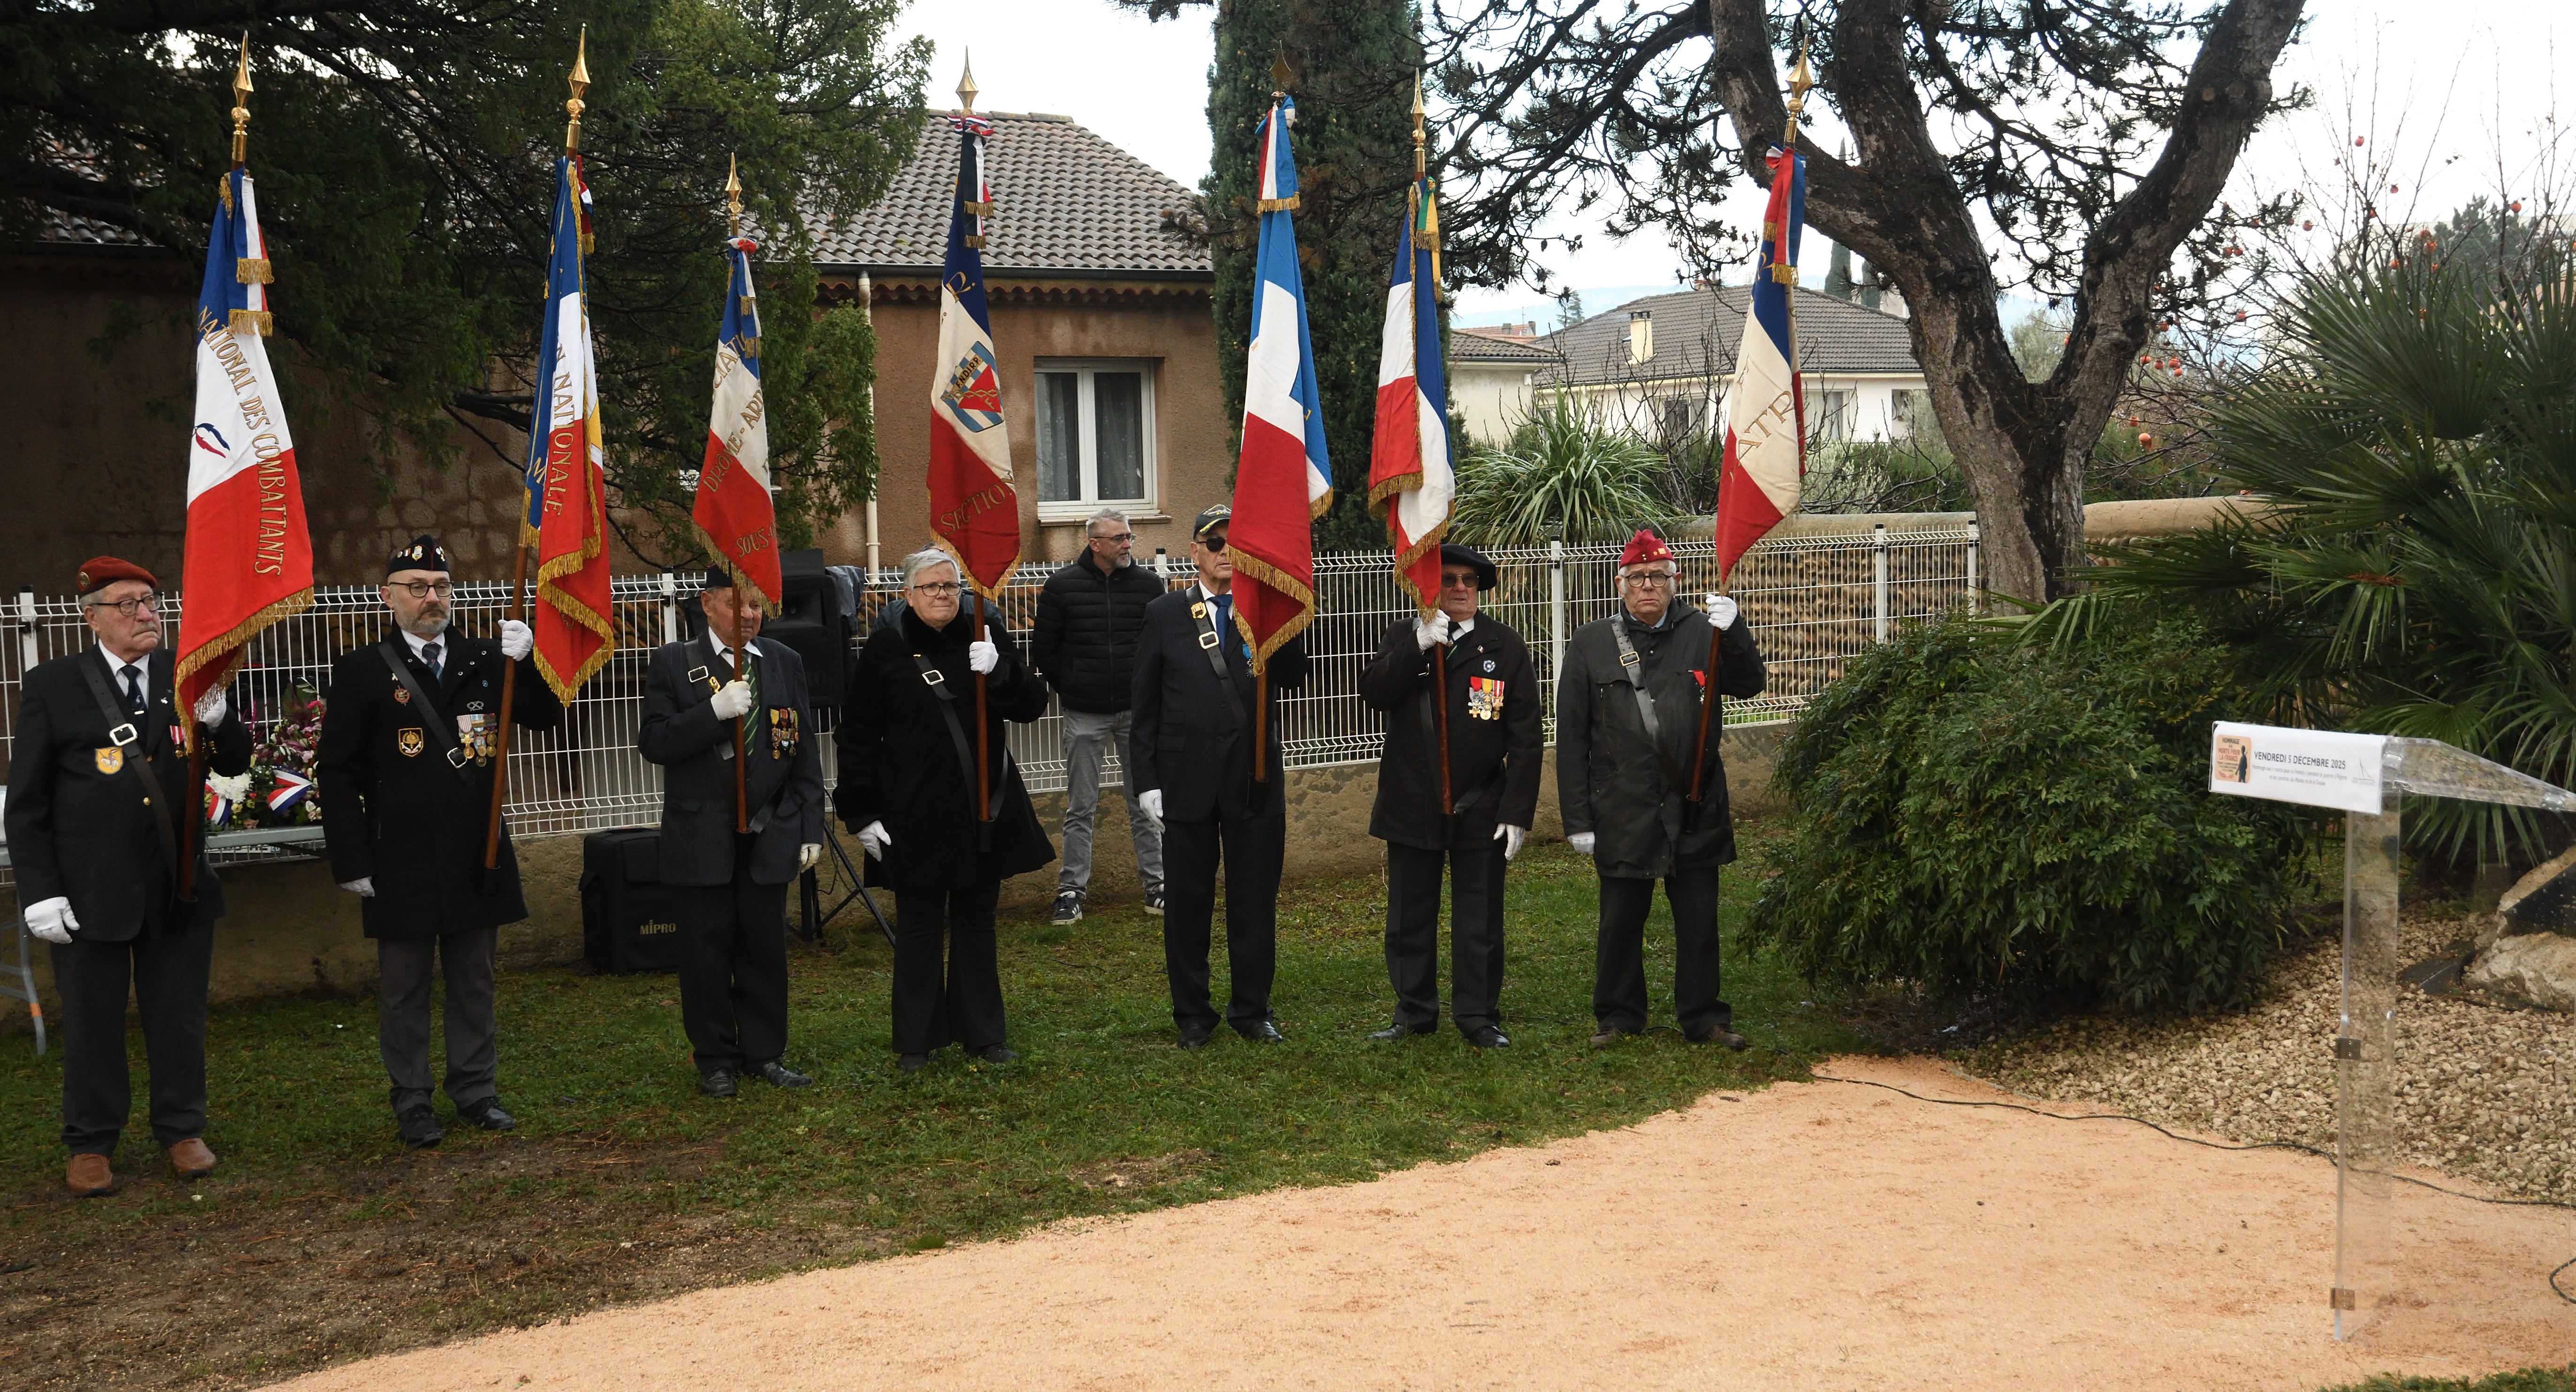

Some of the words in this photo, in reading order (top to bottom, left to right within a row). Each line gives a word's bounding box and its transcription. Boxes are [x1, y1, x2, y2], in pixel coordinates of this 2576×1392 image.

[198, 304, 257, 396] NATIONAL
[240, 396, 271, 430] DES
[544, 371, 575, 517] NATIONALE
[702, 431, 743, 493] DRÔME
[252, 433, 287, 576] COMBATTANTS
[2254, 752, 2286, 763] VENDREDI
[2288, 755, 2292, 763] 5
[2293, 753, 2329, 768] DÉCEMBRE
[2331, 759, 2346, 769] 2025
